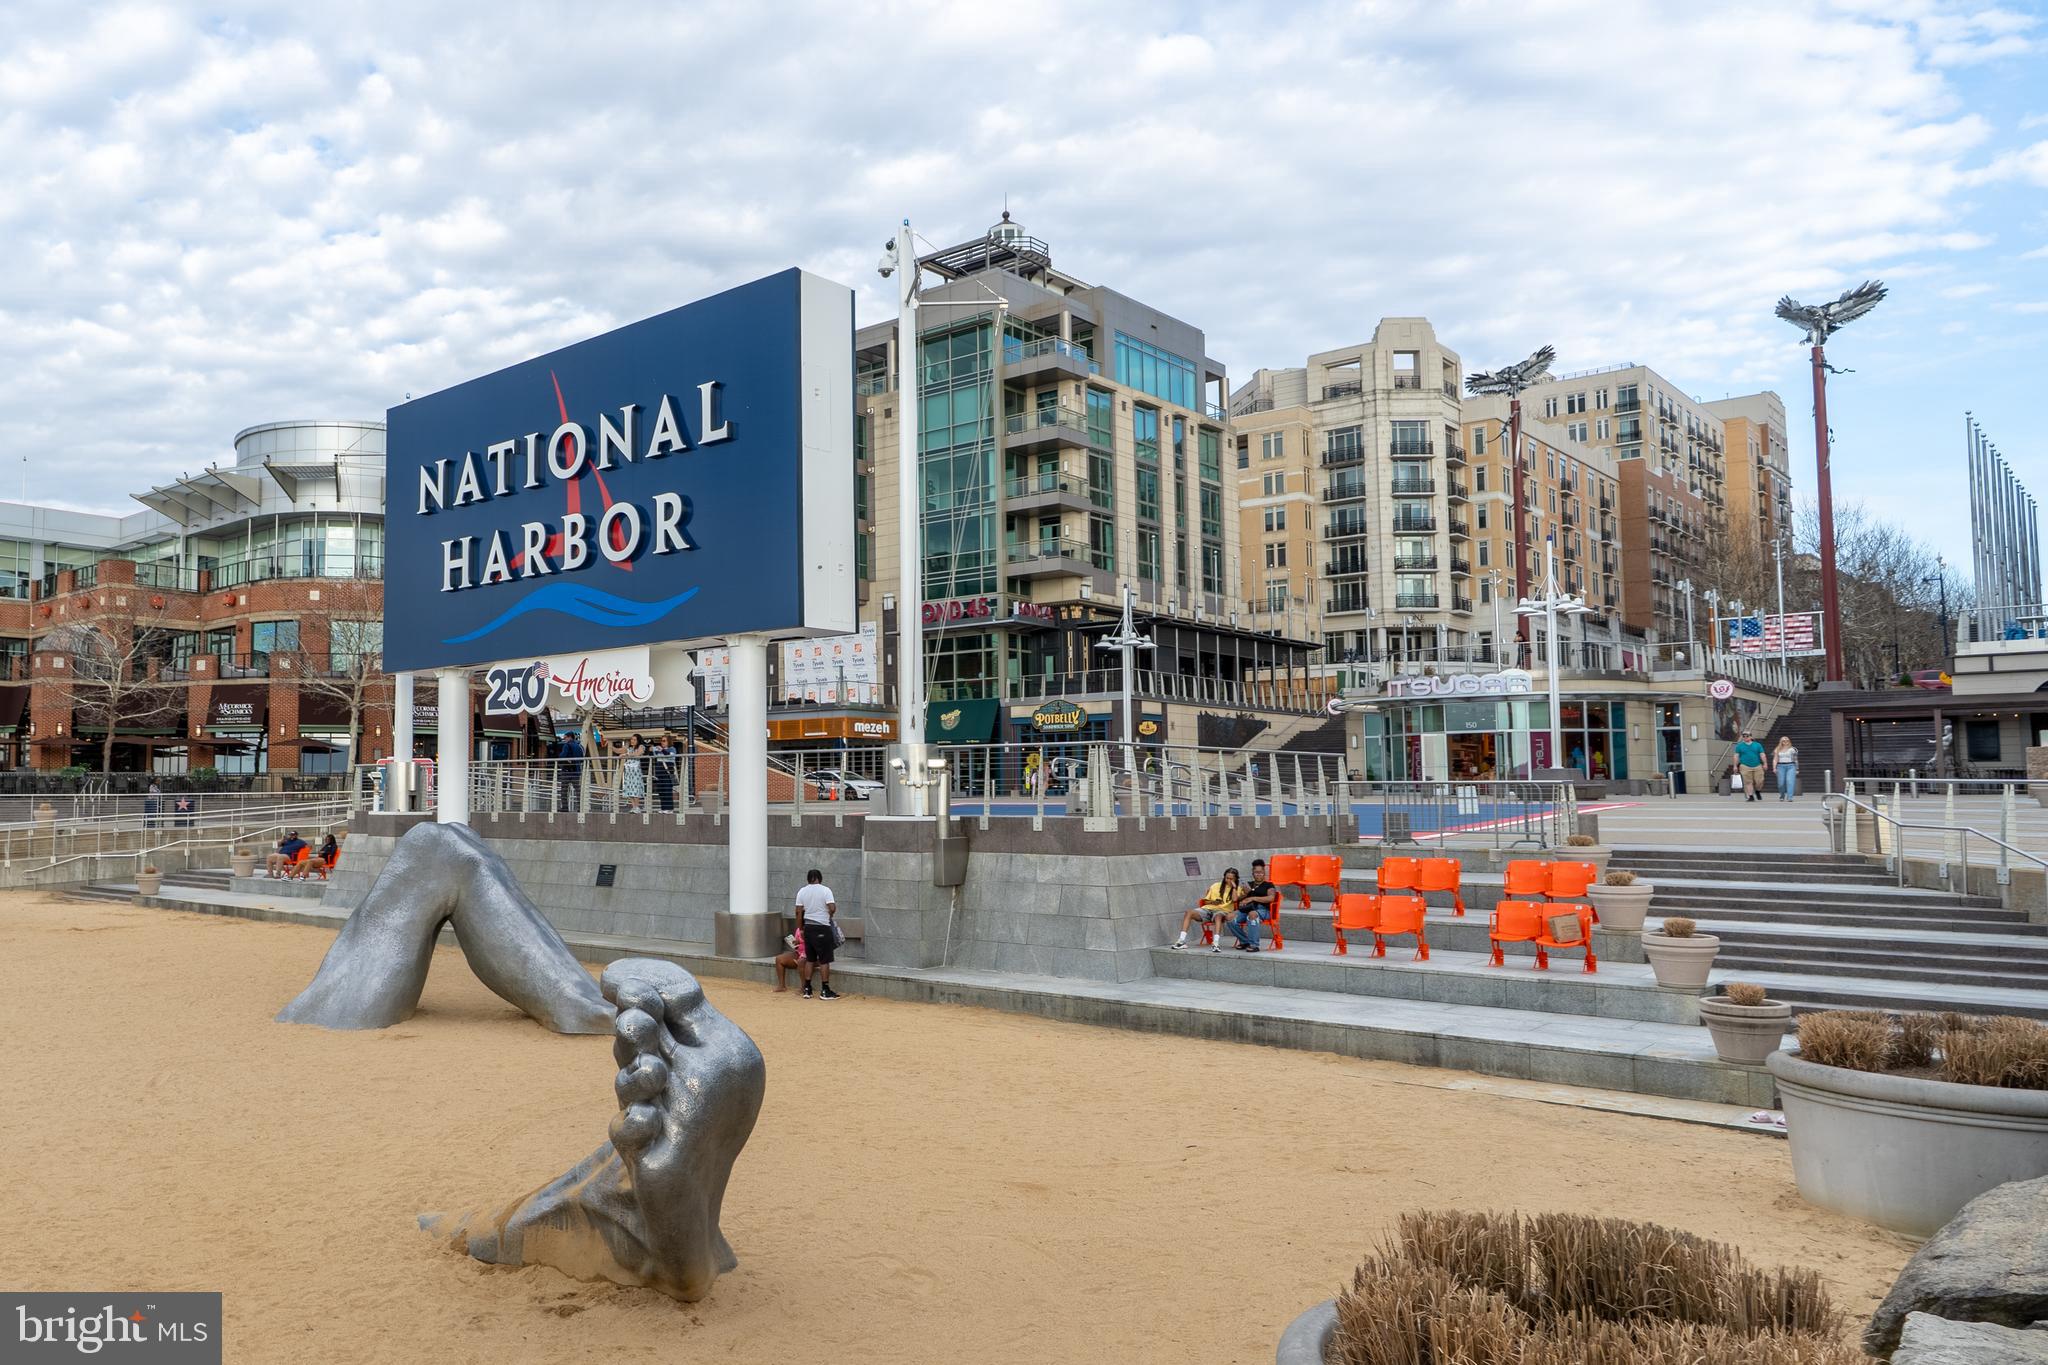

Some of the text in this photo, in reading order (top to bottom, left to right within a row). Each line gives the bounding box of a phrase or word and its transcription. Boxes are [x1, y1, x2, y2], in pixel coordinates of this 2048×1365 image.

[417, 380, 731, 516] NATIONAL
[440, 491, 693, 592] HARBOR
[921, 597, 991, 623] OND 45
[487, 657, 650, 711] 250 America
[1387, 670, 1531, 697] IT'SUGAR
[854, 721, 890, 733] mezeh
[1035, 710, 1080, 726] POTBELLY
